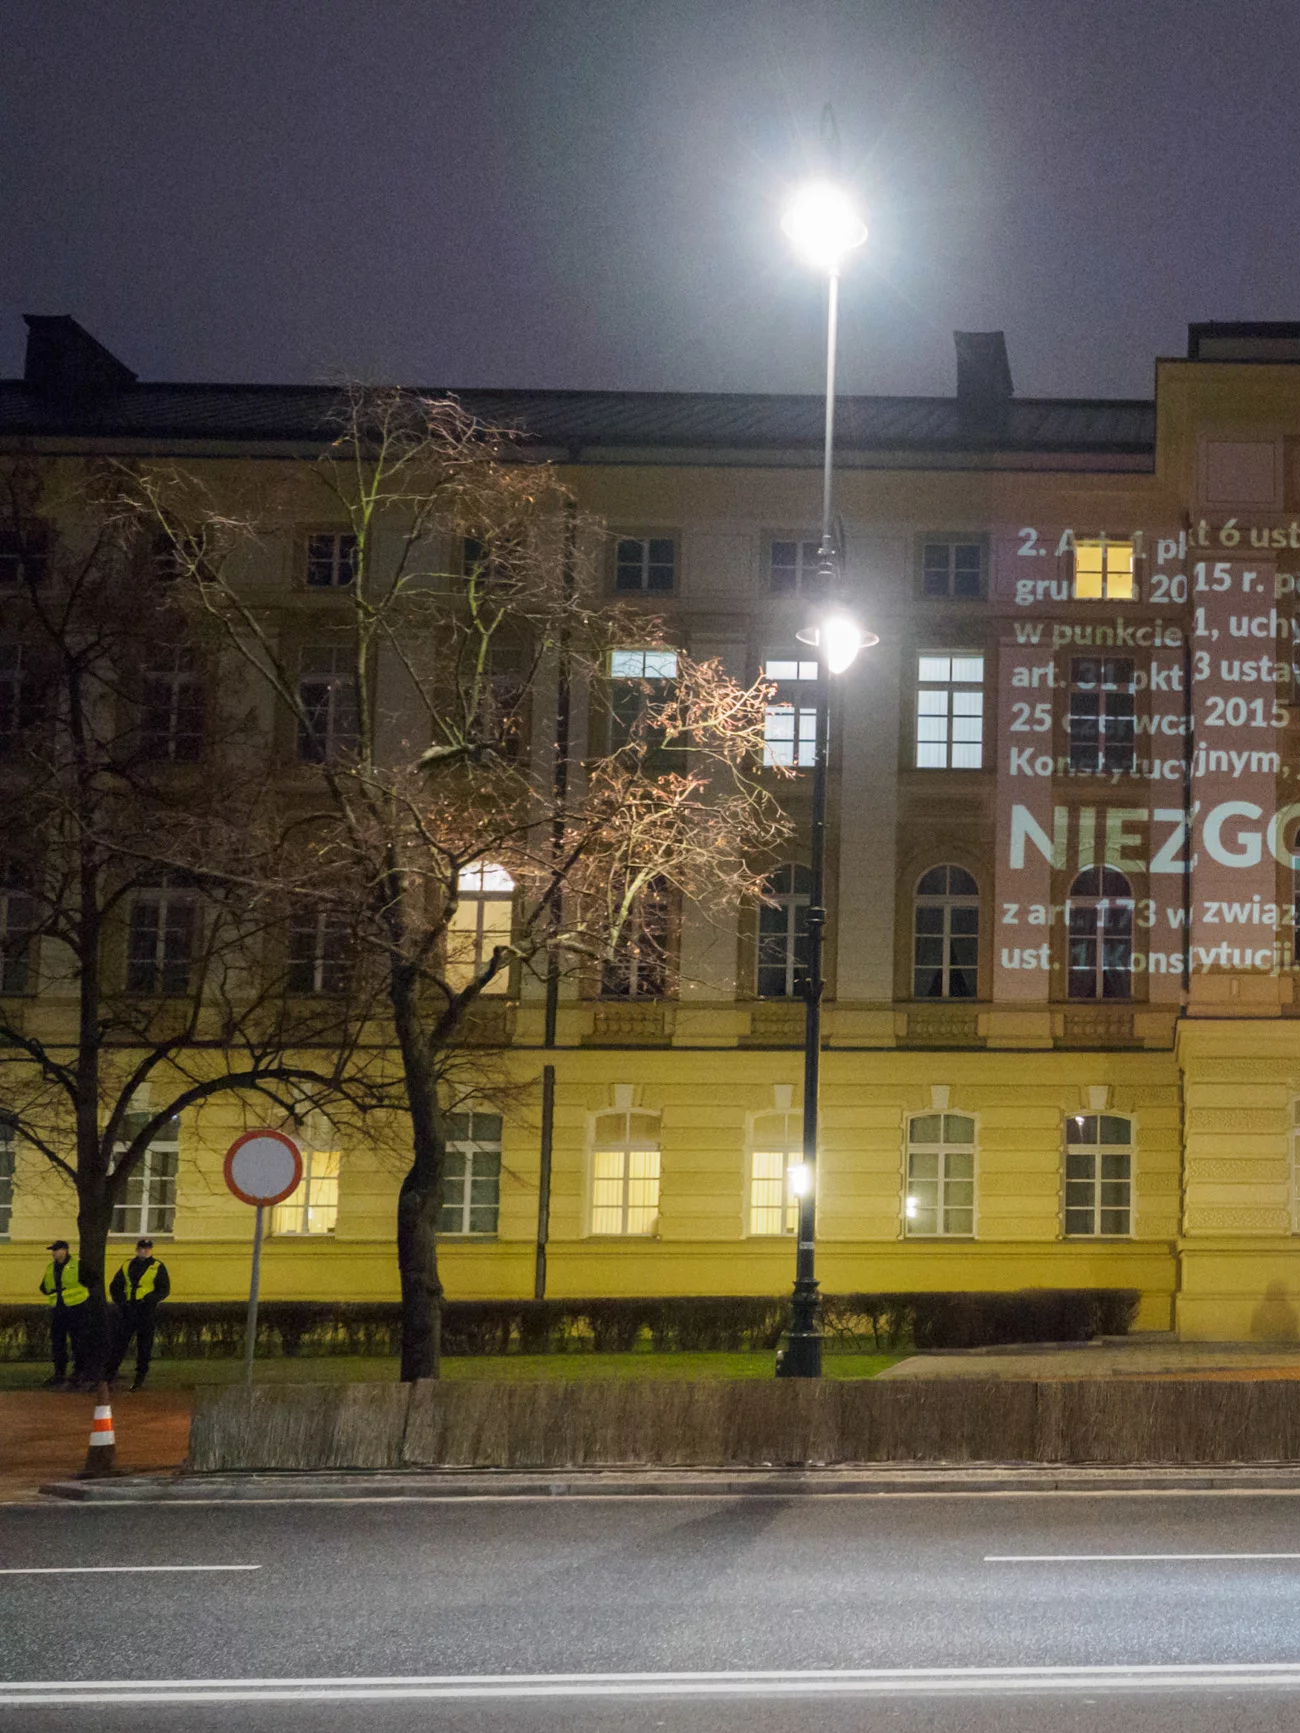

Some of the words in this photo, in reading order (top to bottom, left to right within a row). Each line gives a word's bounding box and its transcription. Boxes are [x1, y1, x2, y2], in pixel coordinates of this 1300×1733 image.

[1017, 527, 1046, 557] 2.
[1157, 518, 1210, 564] pkt
[1219, 518, 1240, 547] 6
[1150, 562, 1232, 604] 2015
[1242, 571, 1264, 592] r.
[1053, 617, 1183, 650] punkcie
[1194, 607, 1219, 641] 1,
[1011, 661, 1067, 689] art.
[1128, 661, 1184, 695] pkt
[1194, 651, 1210, 681] 3
[1010, 702, 1053, 732] 25
[1205, 696, 1289, 729] 2015
[1002, 903, 1019, 924] z
[1167, 909, 1193, 929] w
[1001, 943, 1061, 971] ust.
